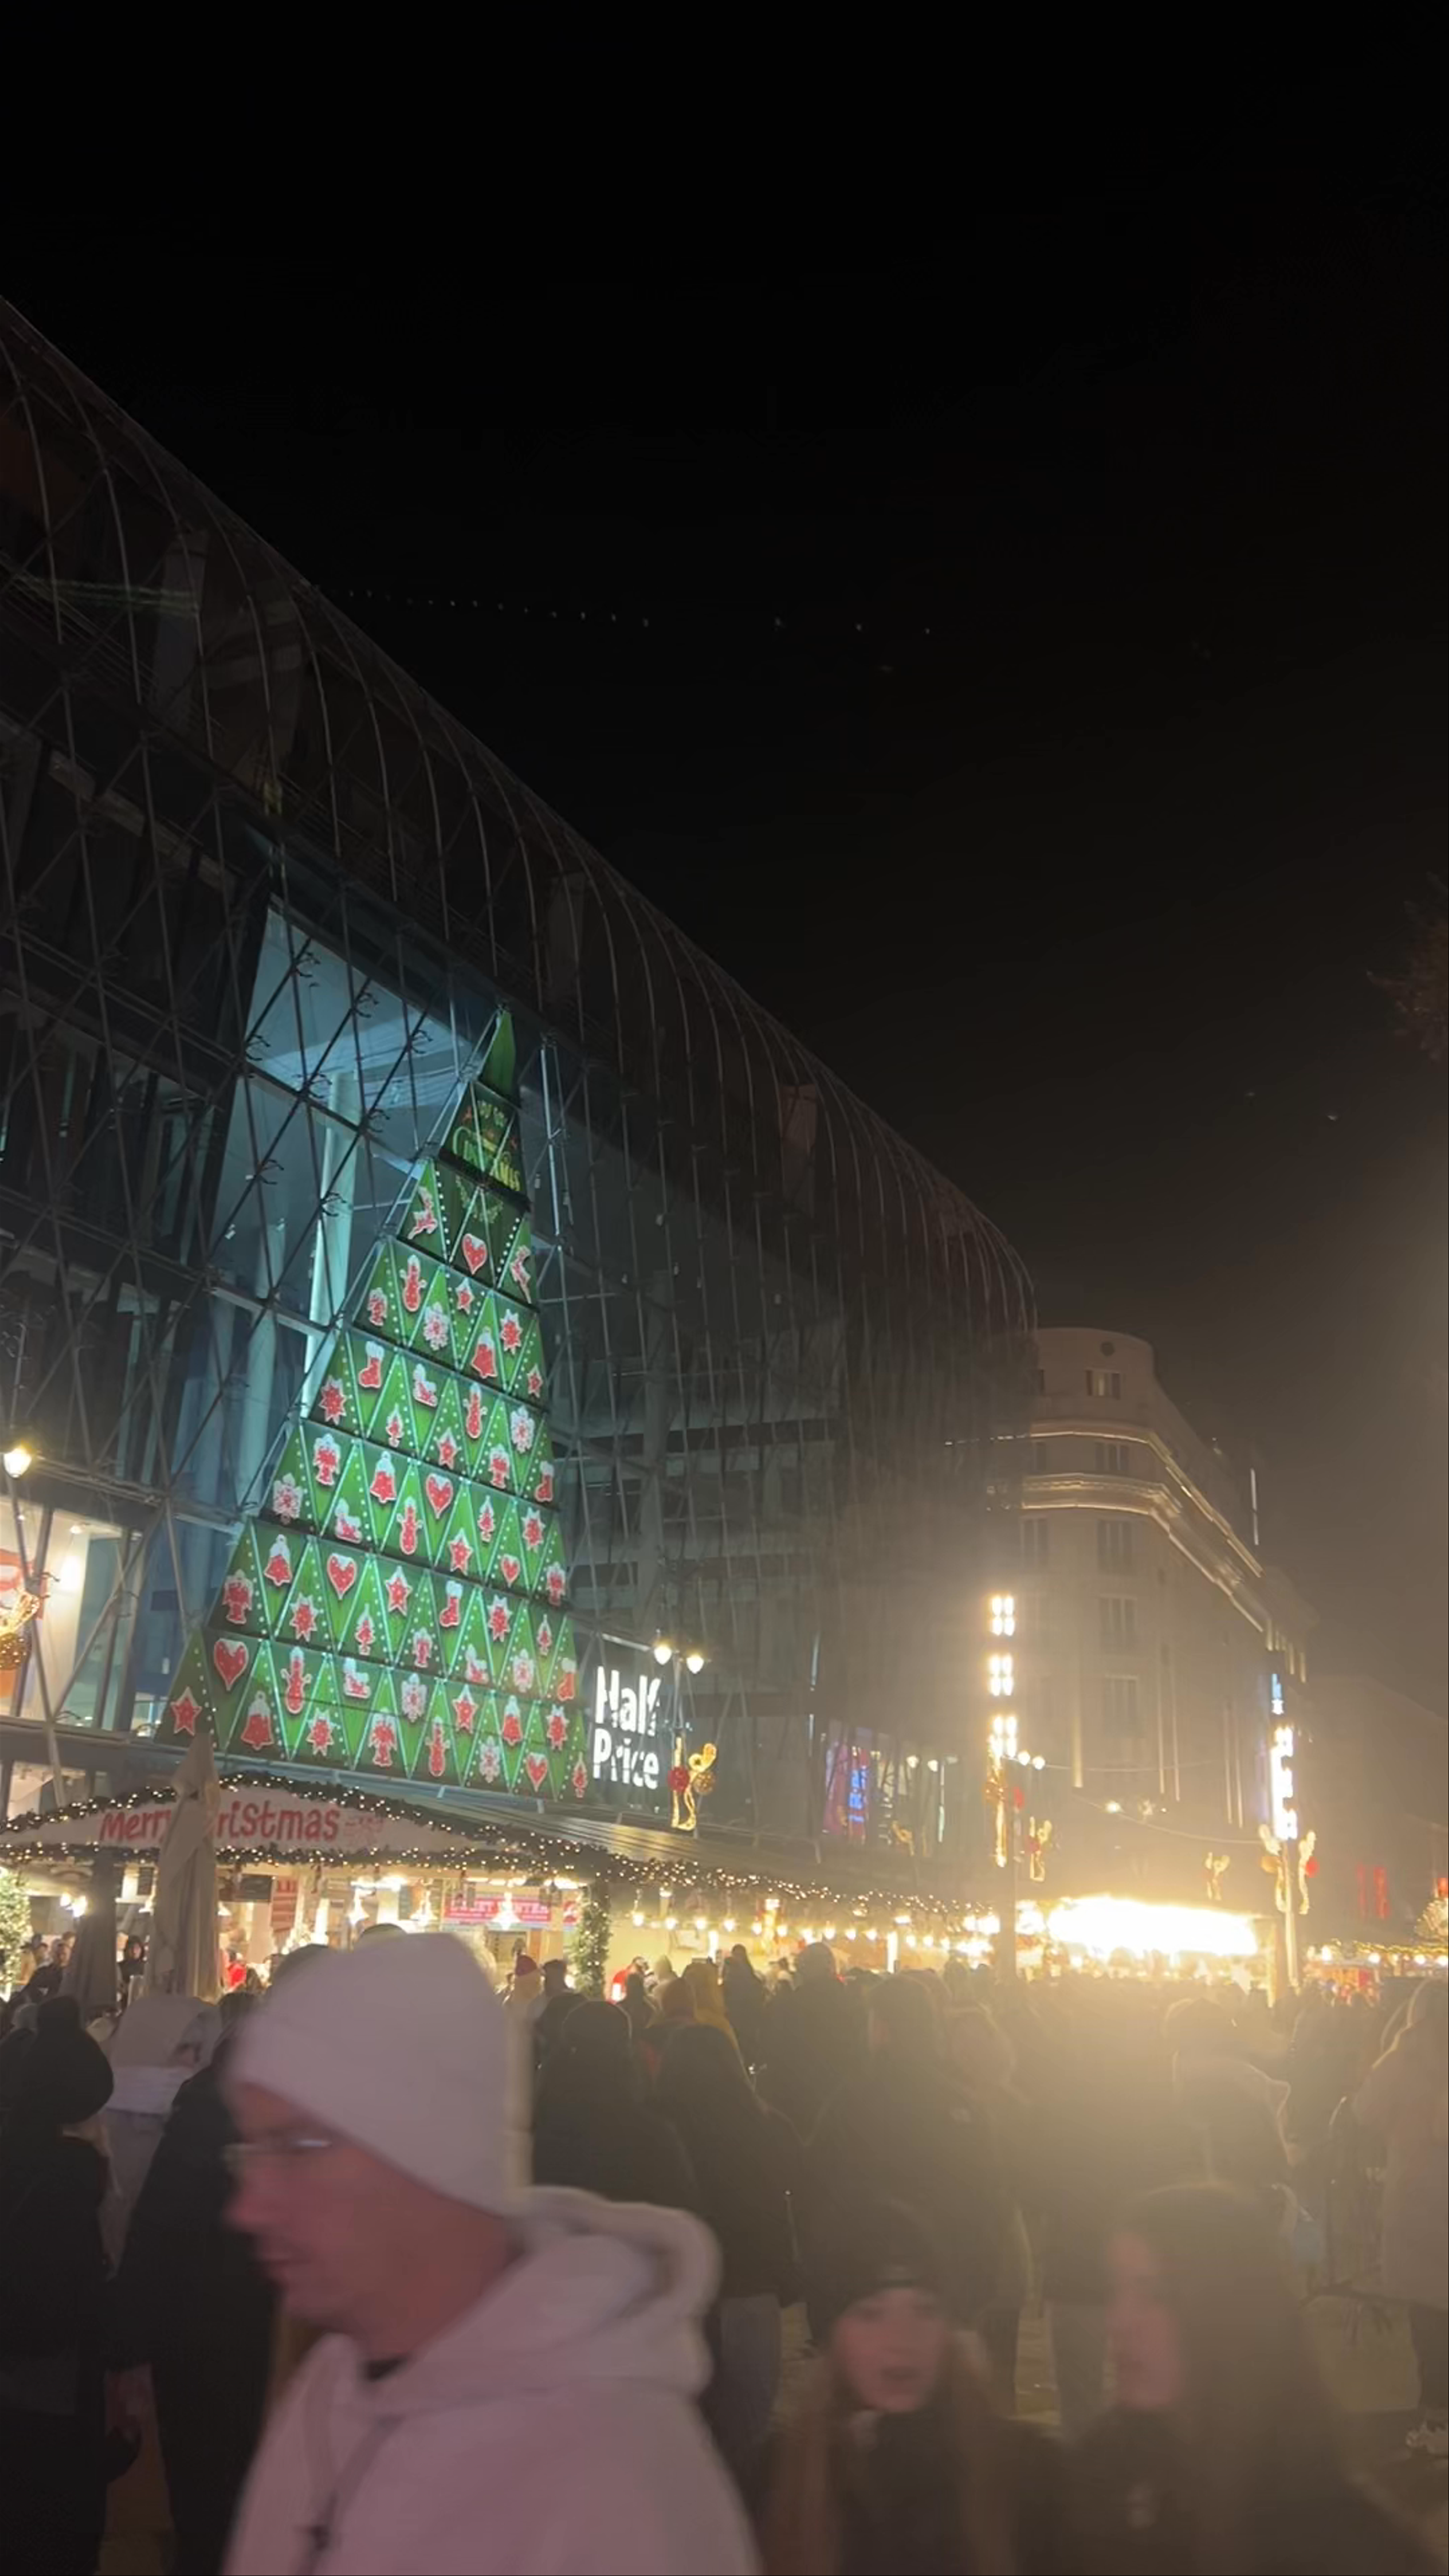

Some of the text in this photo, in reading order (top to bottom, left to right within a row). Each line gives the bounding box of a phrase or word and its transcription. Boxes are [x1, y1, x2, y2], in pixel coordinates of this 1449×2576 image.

[595, 1666, 661, 1736] Half
[593, 1727, 660, 1789] Price
[211, 1800, 340, 1841] ristmas
